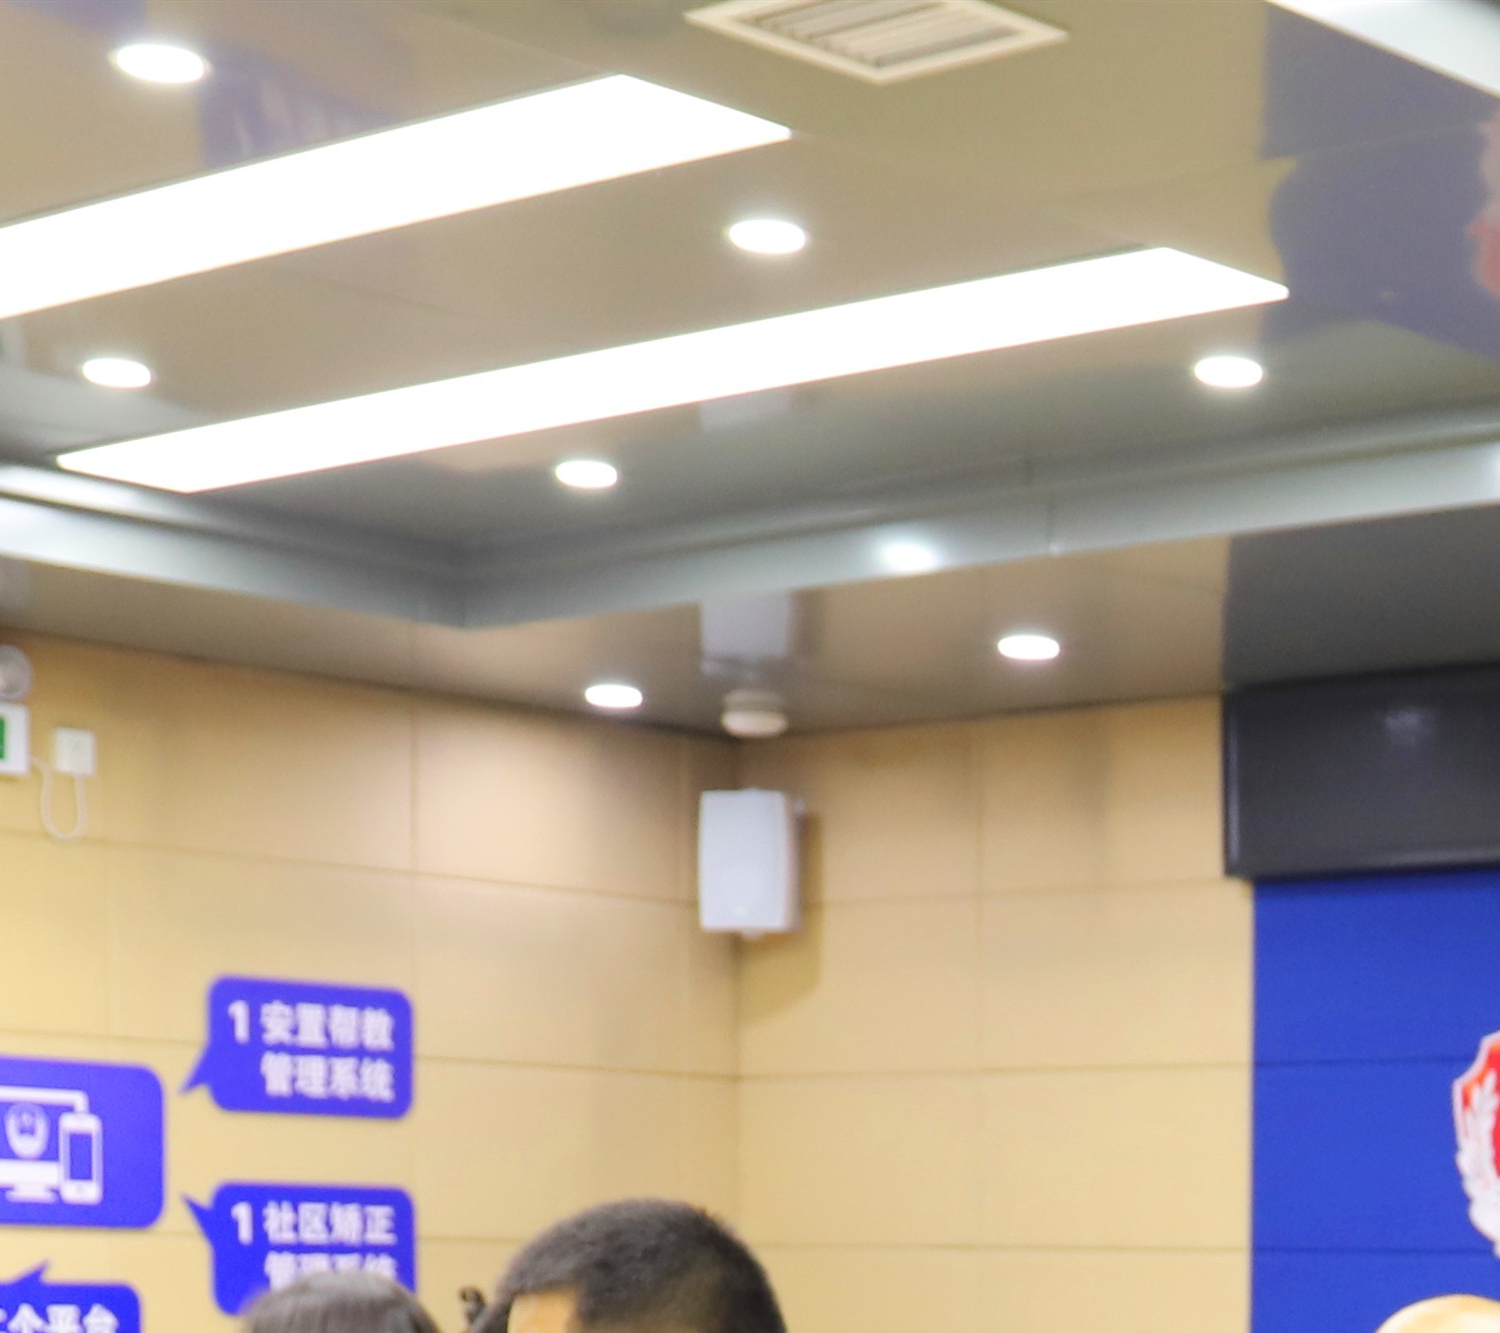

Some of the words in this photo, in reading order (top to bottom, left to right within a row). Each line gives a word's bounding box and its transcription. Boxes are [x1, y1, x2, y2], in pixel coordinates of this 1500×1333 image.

[228, 1000, 249, 1044] 1
[261, 1000, 395, 1050] 安置帮教
[261, 1051, 396, 1103] 管理系统
[231, 1201, 253, 1245] 1
[263, 1200, 397, 1246] 社区矫正
